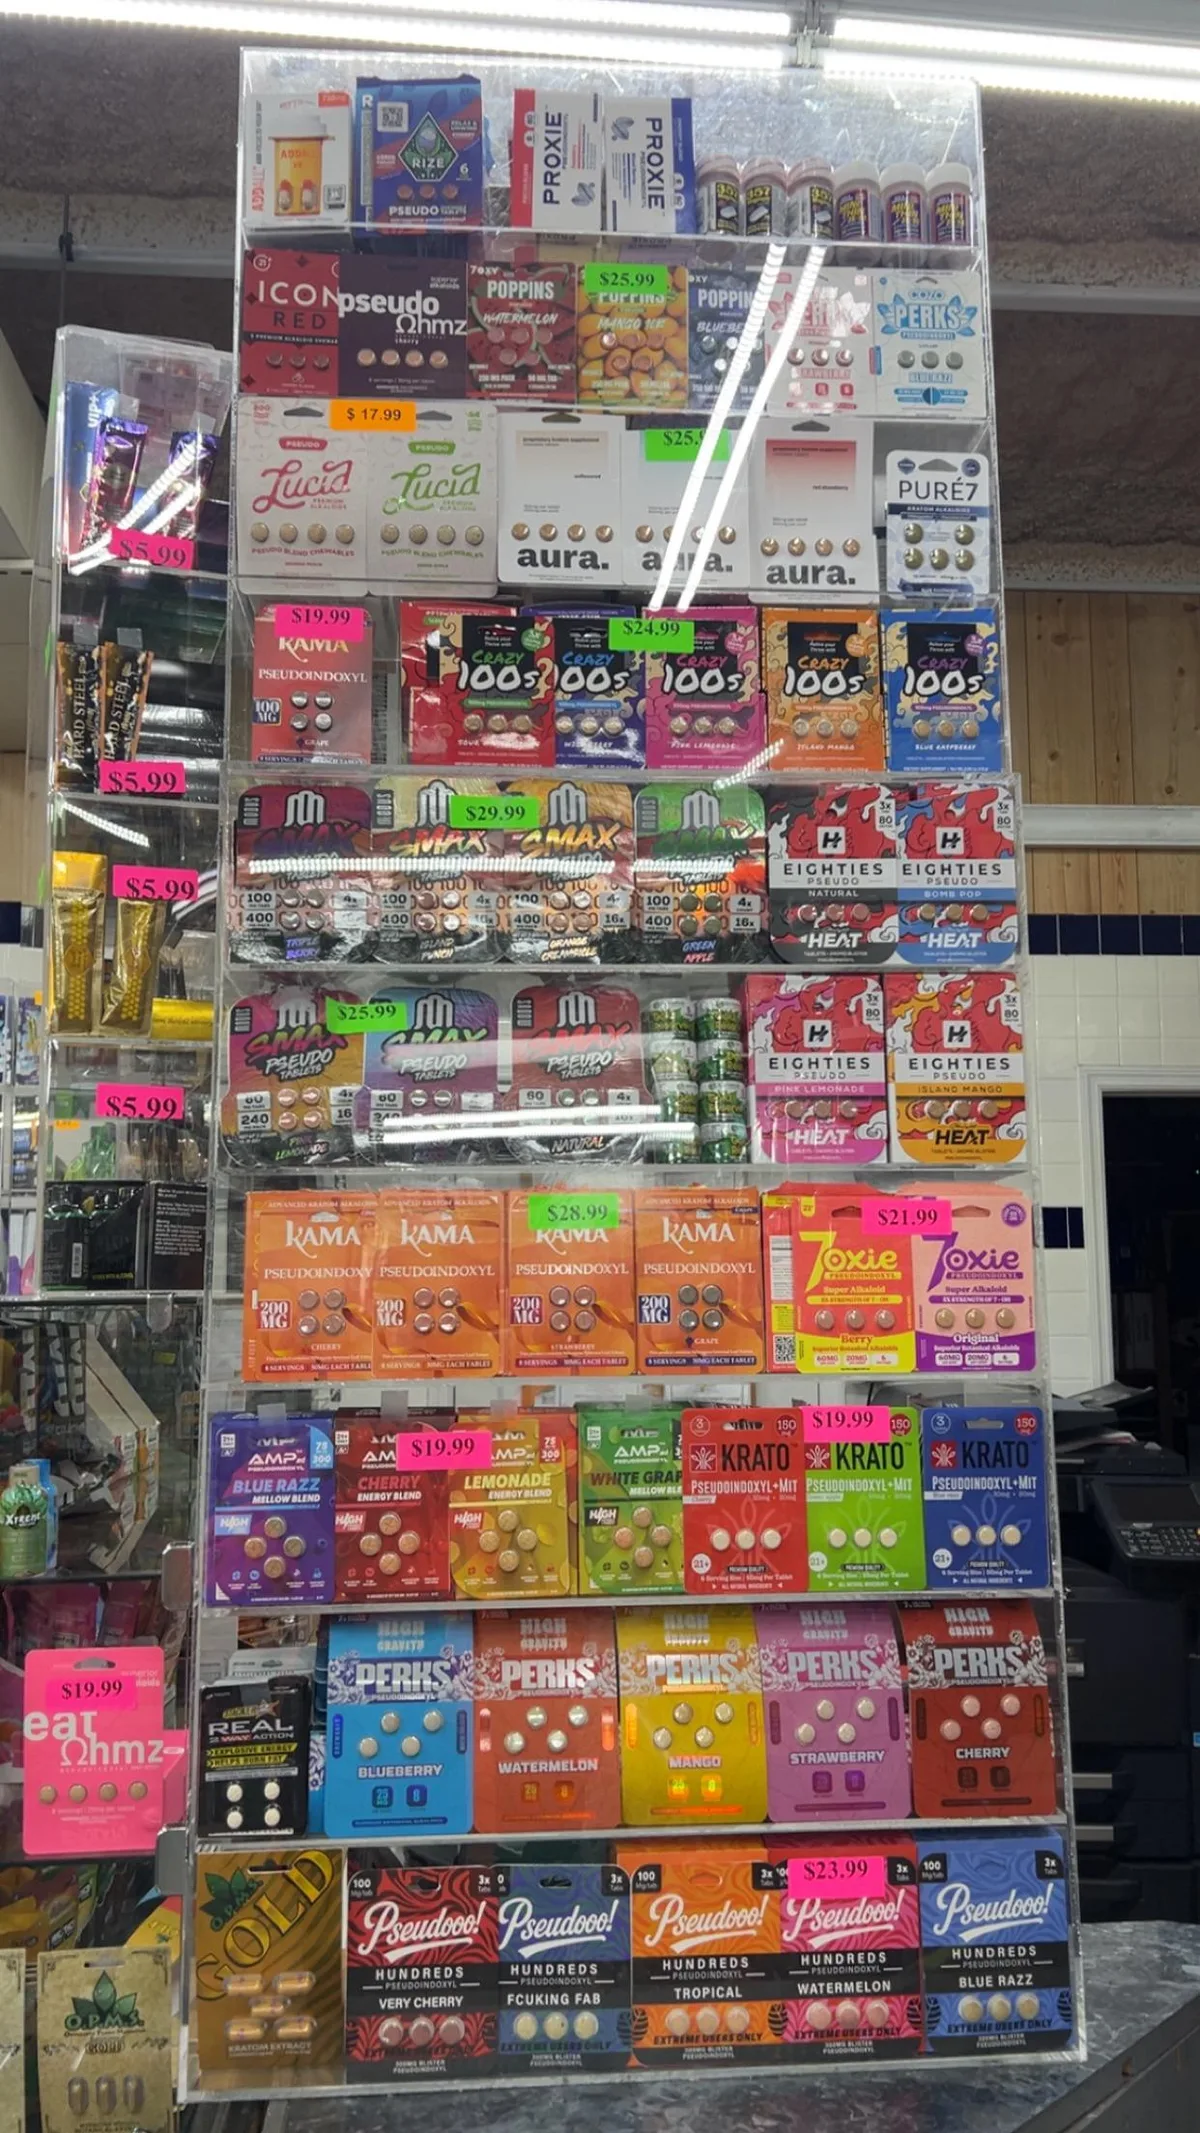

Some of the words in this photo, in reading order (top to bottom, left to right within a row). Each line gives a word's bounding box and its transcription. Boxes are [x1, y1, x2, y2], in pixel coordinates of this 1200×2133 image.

[412, 157, 445, 168] RIZE
[543, 112, 562, 205] PROXIE
[645, 117, 665, 209] PROXIE
[460, 162, 469, 174] 6
[389, 205, 439, 216] PSEUDO
[599, 271, 655, 287] $25.99
[258, 280, 339, 308] ICON
[487, 280, 554, 300] POPPINS
[338, 289, 440, 318] pseudo
[274, 311, 326, 329] RED
[483, 312, 558, 325] WATERMELON
[893, 303, 961, 329] PERKS
[346, 407, 356, 421] $
[361, 407, 401, 421] 17.99
[285, 440, 321, 449] PSEUDO
[252, 459, 353, 514] Lucid
[381, 462, 482, 515] Lucid
[899, 476, 979, 502] PURÉ7
[119, 540, 187, 568] $5.99
[517, 547, 609, 570] aura.
[766, 564, 856, 585] aura.
[291, 608, 351, 625] $19.99
[623, 620, 680, 636] $24.99
[471, 650, 525, 665] CRAZY
[561, 651, 615, 666] CRAZY
[676, 655, 729, 668] CRAZY
[258, 669, 367, 683] PSEUDOINDOXYL
[457, 662, 540, 692] 100s
[663, 663, 744, 694] 100s
[74, 675, 86, 717] STEEL
[255, 701, 279, 713] 100
[257, 713, 277, 723] MG
[107, 769, 178, 794] $5.99
[466, 805, 526, 821] $29.99
[879, 816, 893, 825] 80
[997, 816, 1011, 825] 80
[390, 825, 487, 859] SMAX
[783, 863, 884, 875] EIGHTIES
[902, 863, 1002, 876] EIGHTIES
[125, 875, 195, 901] $5.99
[808, 889, 860, 897] NATURAL
[924, 890, 956, 898] BOMB
[959, 890, 982, 898] POP
[247, 892, 272, 903] 100
[382, 893, 407, 904] 100
[245, 912, 274, 923] 400
[381, 914, 409, 925] 400
[513, 914, 540, 925] 400
[604, 914, 625, 924] 16x
[682, 940, 716, 951] GREEN
[807, 932, 863, 948] HEAT
[683, 953, 715, 963] APPLE
[337, 1004, 397, 1021] $25.99
[865, 1008, 880, 1018] 80
[769, 1057, 870, 1070] EIGHTIES
[909, 1057, 1010, 1070] EIGHTIES
[526, 1090, 544, 1101] 60
[774, 1085, 801, 1093] PINK
[804, 1085, 865, 1093] LEMONADE
[918, 1086, 957, 1094] ISLAND
[962, 1086, 1002, 1094] MANGO
[106, 1095, 178, 1120] $5.99
[241, 1113, 269, 1125] 240
[547, 1204, 608, 1222] $28.99
[877, 1208, 937, 1226] $21.99
[643, 1262, 756, 1274] PSEUDOINDOXYL
[798, 1231, 898, 1292] 7oxie
[379, 1265, 495, 1278] PSEUDOINDOXYL
[515, 1263, 629, 1275] PSEUDOINDOXYL
[824, 1286, 849, 1294] Super
[850, 1285, 886, 1293] Alkaloid
[945, 1286, 972, 1294] Super
[973, 1285, 1008, 1293] Alkaloid
[260, 1301, 288, 1315] 200
[513, 1296, 540, 1310] 200
[841, 1334, 873, 1346] Berry
[953, 1333, 999, 1345] Original
[310, 1343, 341, 1351] CHERRY
[696, 1418, 704, 1428] 3
[777, 1420, 797, 1430] 150
[812, 1411, 874, 1429] $19.99
[891, 1419, 910, 1429] 150
[936, 1416, 944, 1426] 3
[1016, 1418, 1036, 1428] 150
[411, 1437, 475, 1458] $19.99
[541, 1450, 559, 1459] 300
[962, 1440, 1030, 1468] KRATO
[721, 1443, 790, 1471] KRATO
[835, 1441, 904, 1470] KRATO
[358, 1475, 421, 1490] CHERRY
[590, 1471, 643, 1486] WHITE
[643, 1470, 682, 1483] GRAP
[233, 1479, 273, 1494] BLUE
[275, 1478, 321, 1492] RAZZ
[252, 1494, 291, 1504] MELLOW
[291, 1493, 321, 1503] BLEND
[357, 1492, 393, 1502] ENERGY
[393, 1491, 422, 1500] BLEND
[488, 1490, 523, 1500] ENERGY
[523, 1489, 552, 1498] BLEND
[377, 1620, 425, 1637] HIGH
[933, 1646, 1024, 1678] PERKS
[61, 1679, 123, 1700] $19.99
[208, 1718, 294, 1736] REAL
[221, 1734, 250, 1742] WAY
[252, 1732, 295, 1740] ACTION
[789, 1750, 885, 1766] STRAWBERRY
[955, 1747, 1010, 1760] CHERRY
[498, 1758, 598, 1775] WATERMELON
[668, 1755, 722, 1769] MANGO
[357, 1764, 443, 1780] BLUEBERRY
[803, 1860, 868, 1881] $23.99
[478, 1874, 491, 1885] 3x
[933, 1882, 1054, 1937] Pseudooo!
[196, 1849, 335, 2002] GOLD
[358, 1899, 487, 1956] Pseudooo!
[510, 1963, 599, 1976] HUNDREDS
[662, 1957, 750, 1971] HUNDREDS
[375, 1966, 464, 1981] HUNDREDS
[958, 1975, 994, 1988] BLUE
[998, 1973, 1034, 1987] RAZZ
[674, 1986, 743, 2000] TROPICAL
[797, 1980, 892, 1995] WATERMELON
[378, 1997, 411, 2010] VERY
[413, 1995, 464, 2008] CHERRY
[506, 1993, 570, 2006] FCUKING
[574, 1993, 601, 2005] FAB
[654, 2035, 700, 2045] EXTREME
[702, 2033, 735, 2043] USERS
[736, 2032, 763, 2042] ONLY
[228, 2043, 269, 2052] KRATOM
[269, 2042, 312, 2051] EXTRACT
